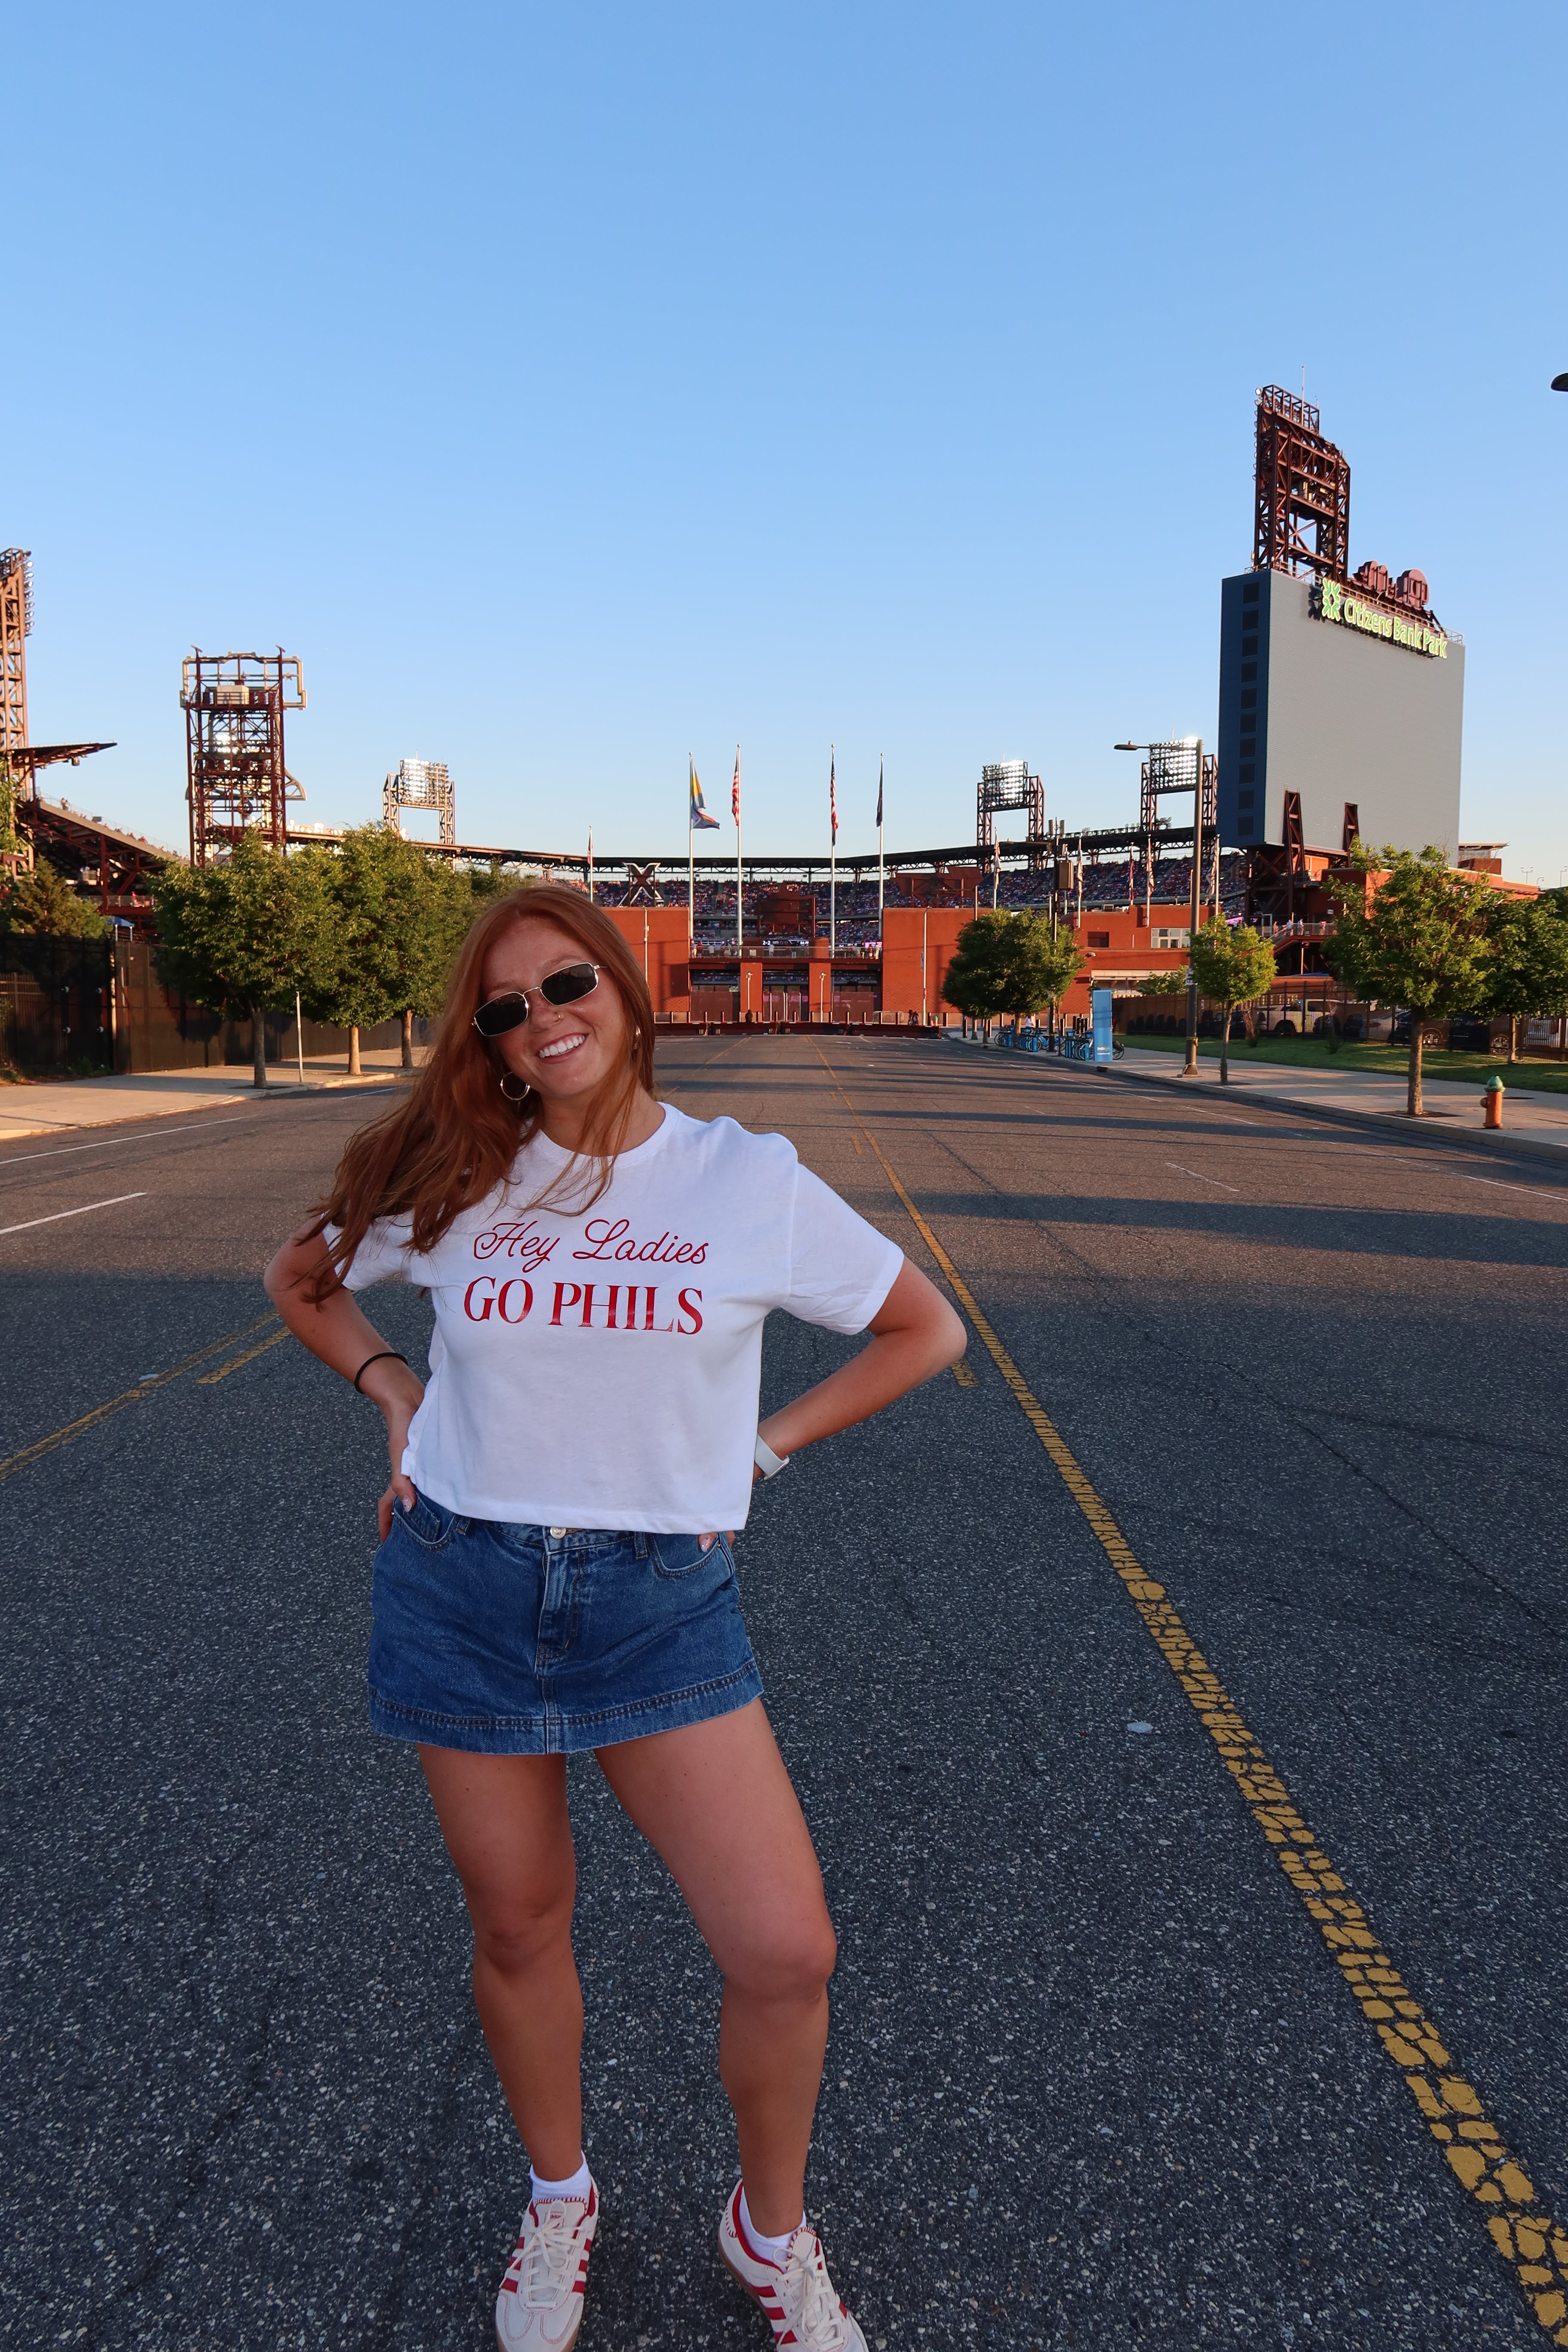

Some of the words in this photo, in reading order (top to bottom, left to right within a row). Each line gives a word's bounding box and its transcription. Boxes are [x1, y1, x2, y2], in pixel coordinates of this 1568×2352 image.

[1344, 597, 1393, 638] Citizens
[1393, 616, 1422, 649] Bank
[1422, 628, 1448, 658] Park
[474, 1220, 560, 1273] Hey
[573, 1219, 708, 1264] Ladies
[464, 1276, 533, 1323] GO
[548, 1282, 703, 1335] PHILS
